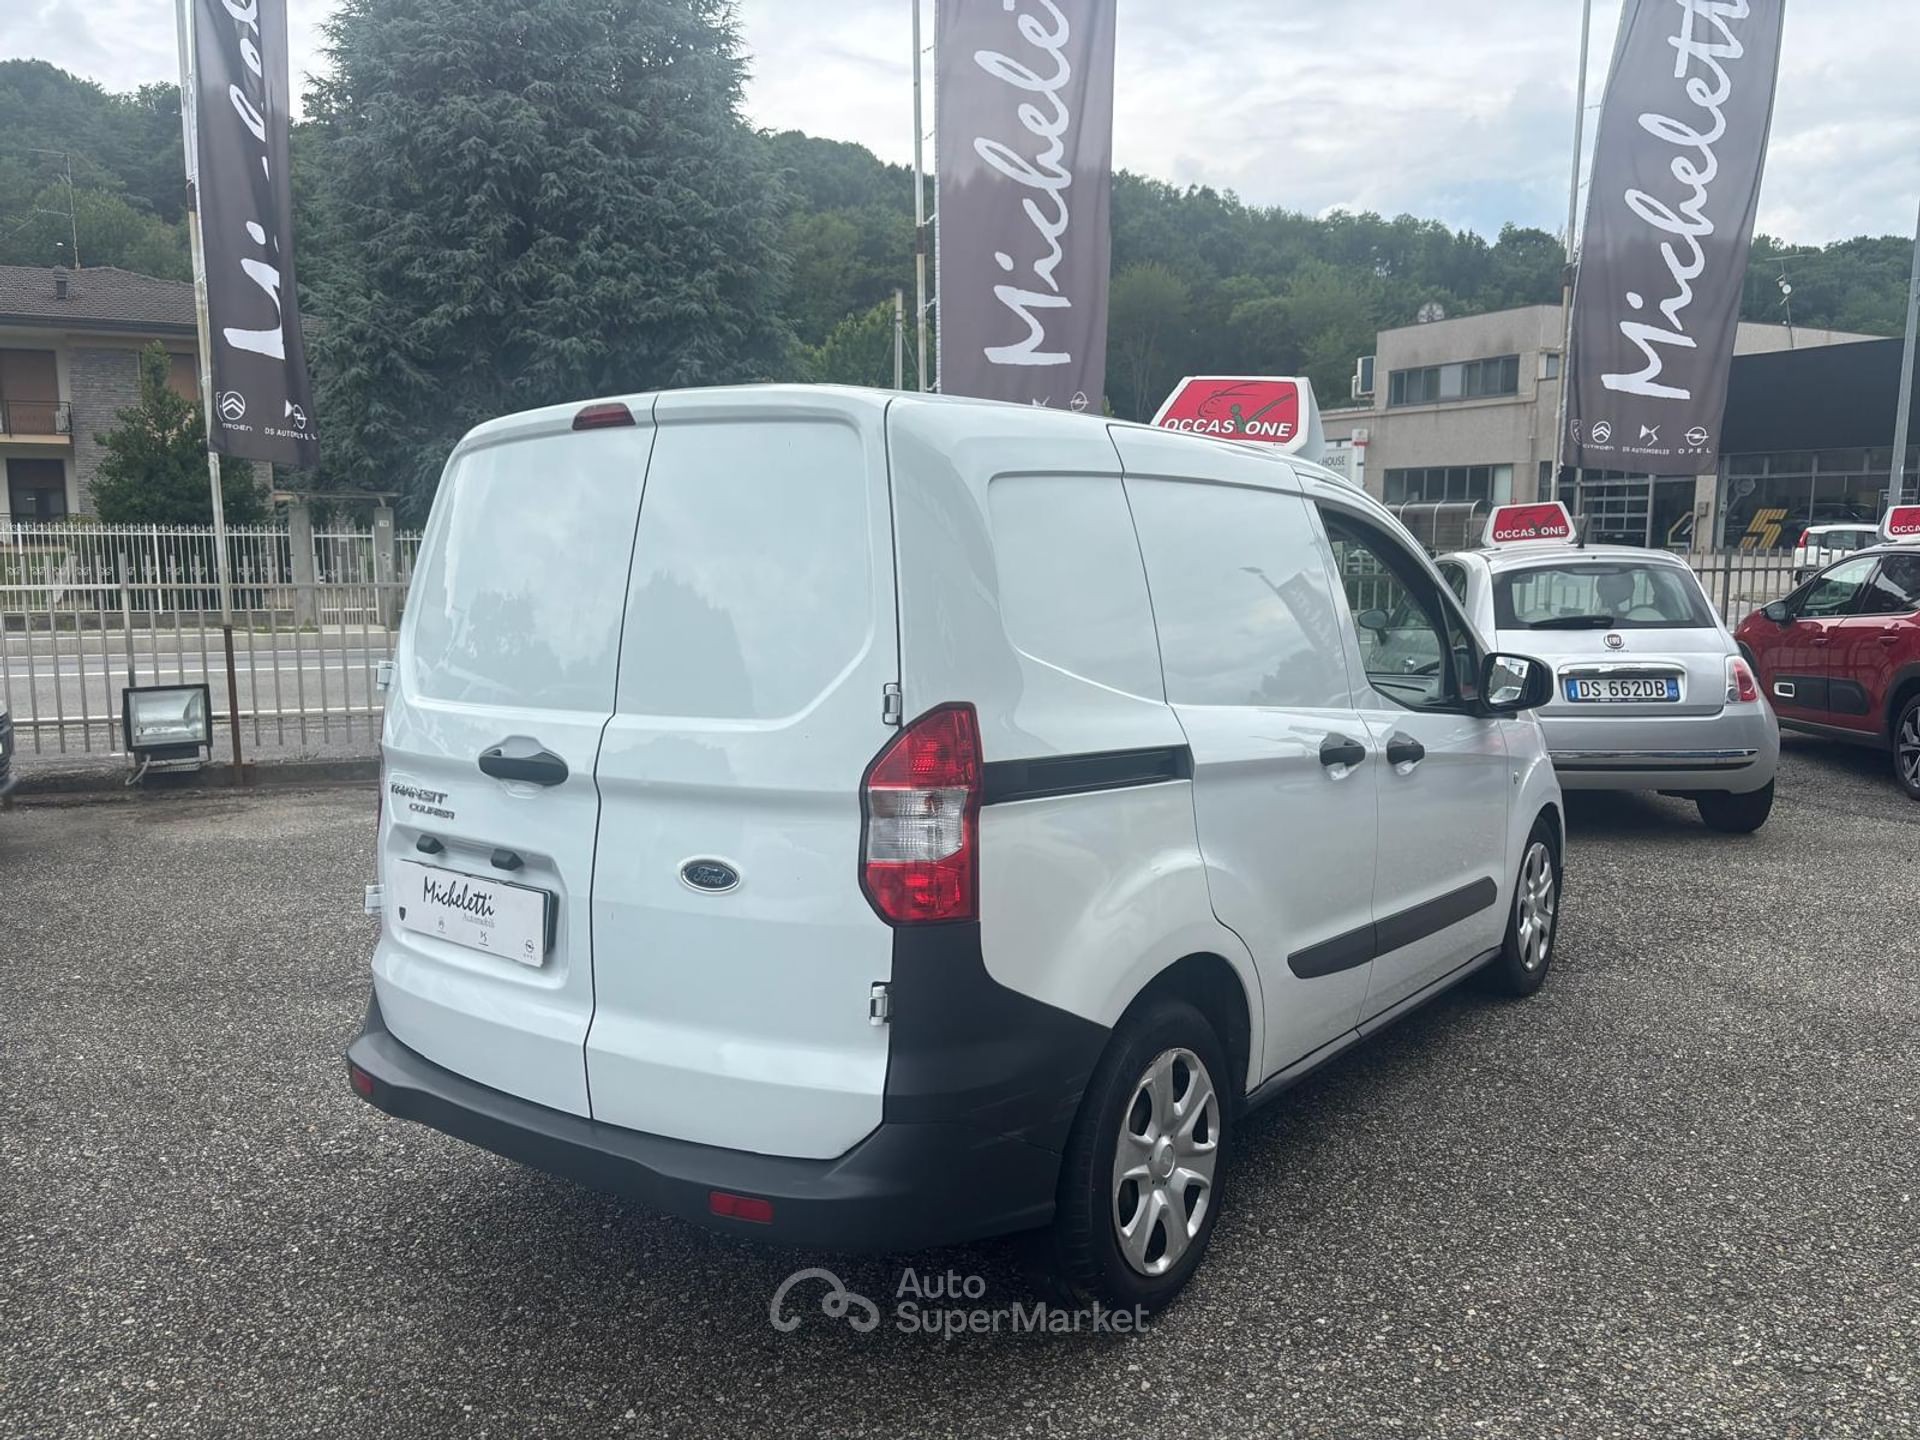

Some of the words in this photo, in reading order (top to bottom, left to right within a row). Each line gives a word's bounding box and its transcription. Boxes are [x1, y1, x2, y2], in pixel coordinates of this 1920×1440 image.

[974, 0, 1072, 366] Michele
[1678, 447, 1712, 455] OPEL
[1608, 680, 1666, 697] 662DB
[388, 783, 448, 805] TRANSIT
[409, 802, 455, 820] COURIER
[692, 866, 726, 886] Ford
[423, 875, 495, 917] Micheletti
